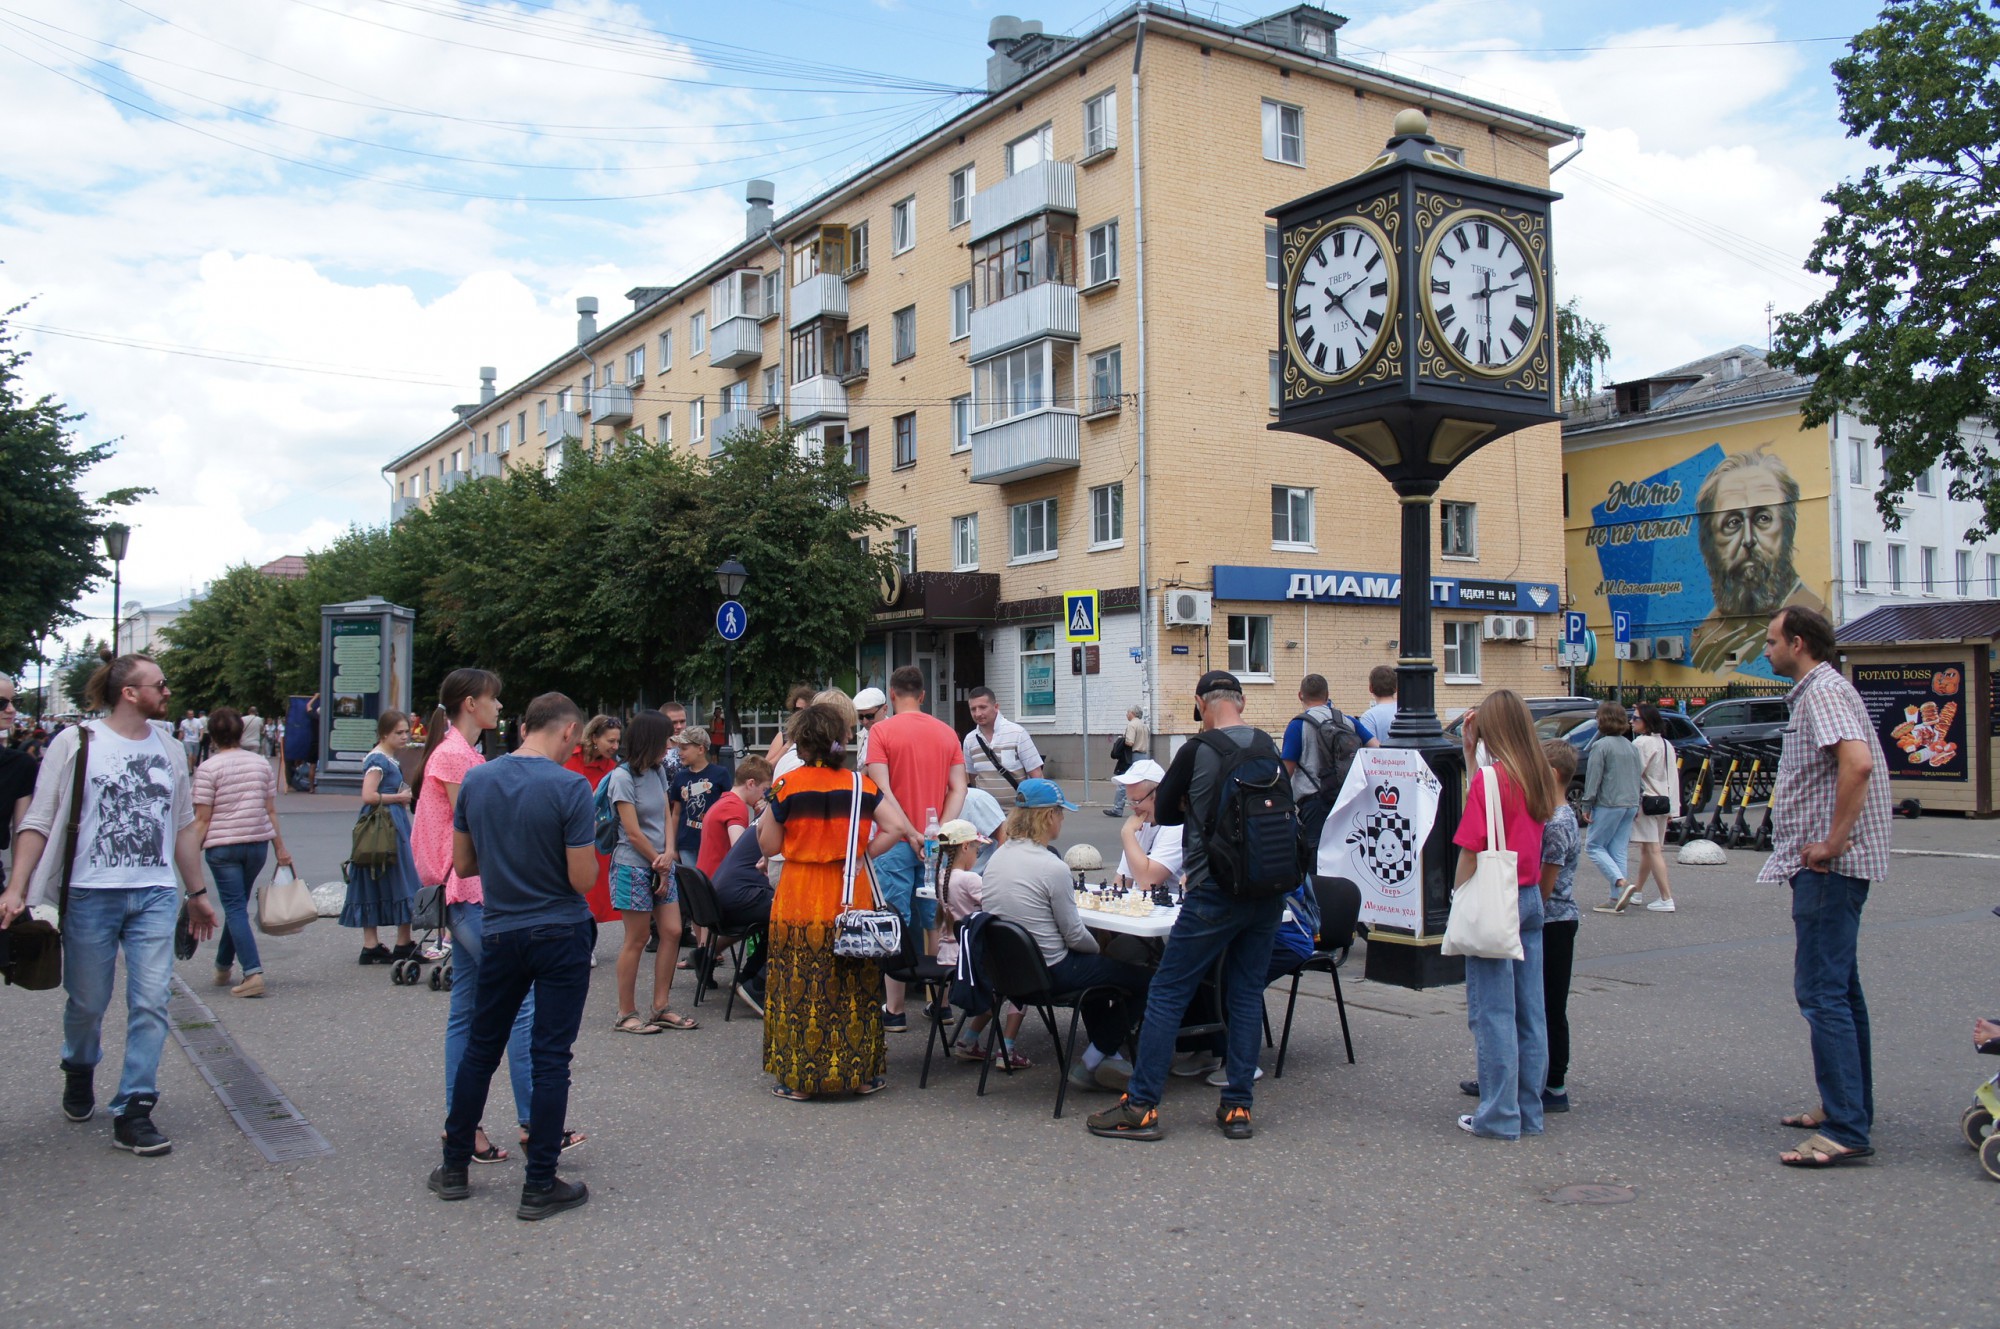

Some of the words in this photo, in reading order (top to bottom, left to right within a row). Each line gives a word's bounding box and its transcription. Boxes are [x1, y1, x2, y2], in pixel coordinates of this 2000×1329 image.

[1471, 264, 1497, 277] ТВЕРЬ
[1328, 271, 1352, 286] ТВЕРЬ
[1333, 319, 1349, 333] 1135
[1605, 480, 1682, 513] Жить
[1585, 527, 1607, 547] не
[1610, 524, 1636, 545] по
[1638, 515, 1693, 541] лжи!
[1286, 574, 1455, 602] ДИАМТ
[1498, 590, 1510, 601] НА
[1570, 615, 1582, 641] P
[1617, 615, 1626, 640] P
[1858, 670, 1900, 680] POTATO
[1903, 669, 1932, 679] BOSS
[1371, 756, 1406, 767] Федерация
